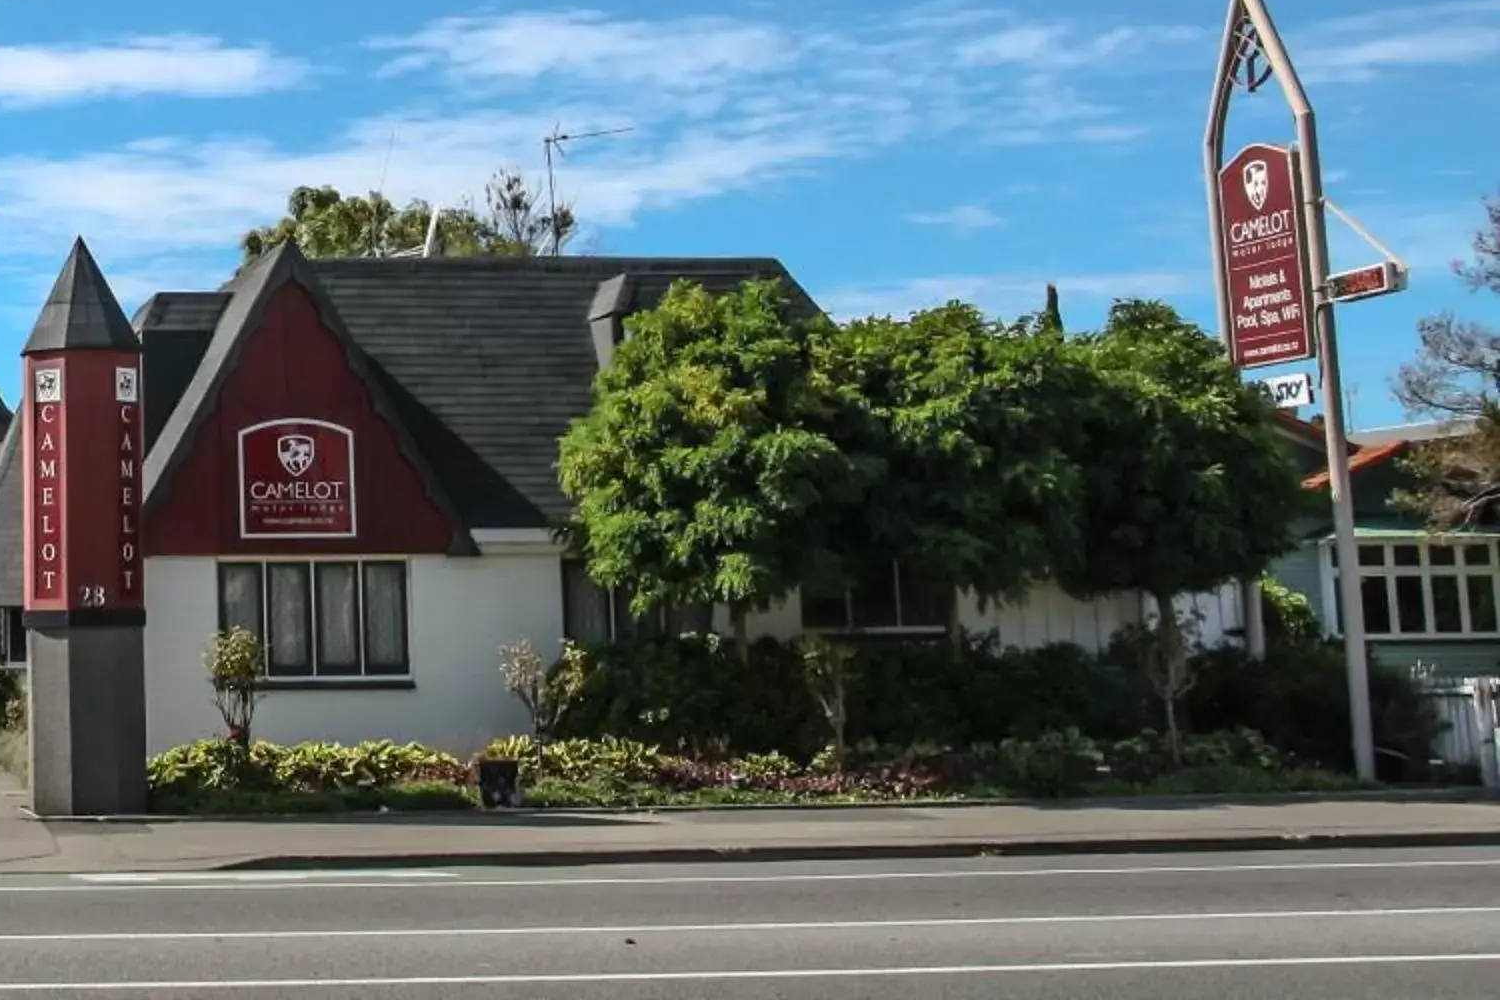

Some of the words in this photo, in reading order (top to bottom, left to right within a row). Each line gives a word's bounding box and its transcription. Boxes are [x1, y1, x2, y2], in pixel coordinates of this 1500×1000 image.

[1230, 209, 1291, 242] CAMELOT
[1260, 309, 1281, 327] Spa,
[40, 405, 56, 590] CAMELOT
[121, 405, 134, 590] CAMELOT
[251, 481, 345, 499] CAMELOT
